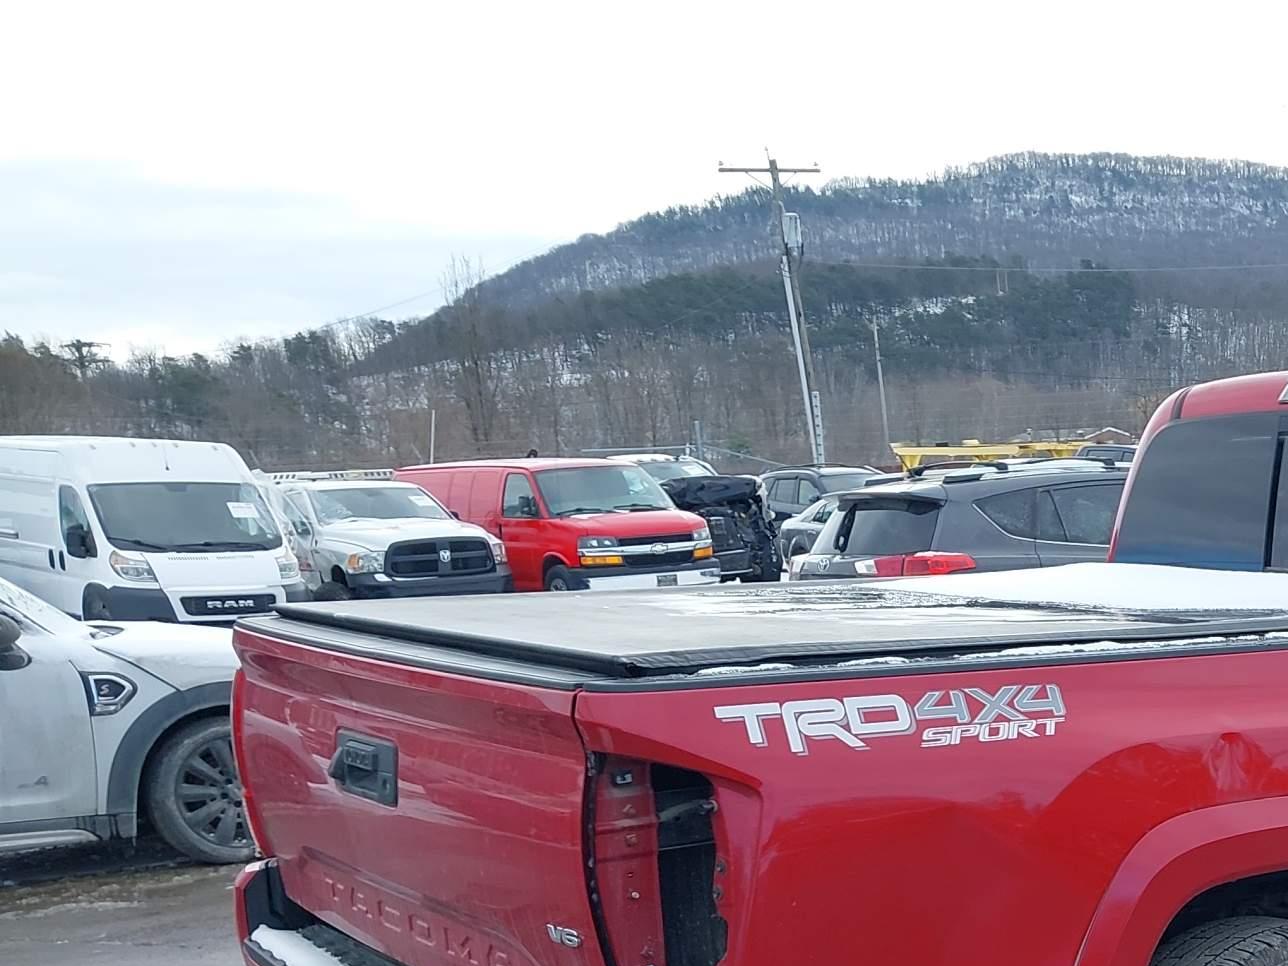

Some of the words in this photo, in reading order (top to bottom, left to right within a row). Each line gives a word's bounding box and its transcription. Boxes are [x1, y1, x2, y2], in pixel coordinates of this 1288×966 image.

[206, 600, 254, 608] RAM
[99, 684, 110, 695] S
[714, 694, 917, 756] TRD
[920, 717, 1066, 748] SPORT
[546, 923, 583, 948] V6
